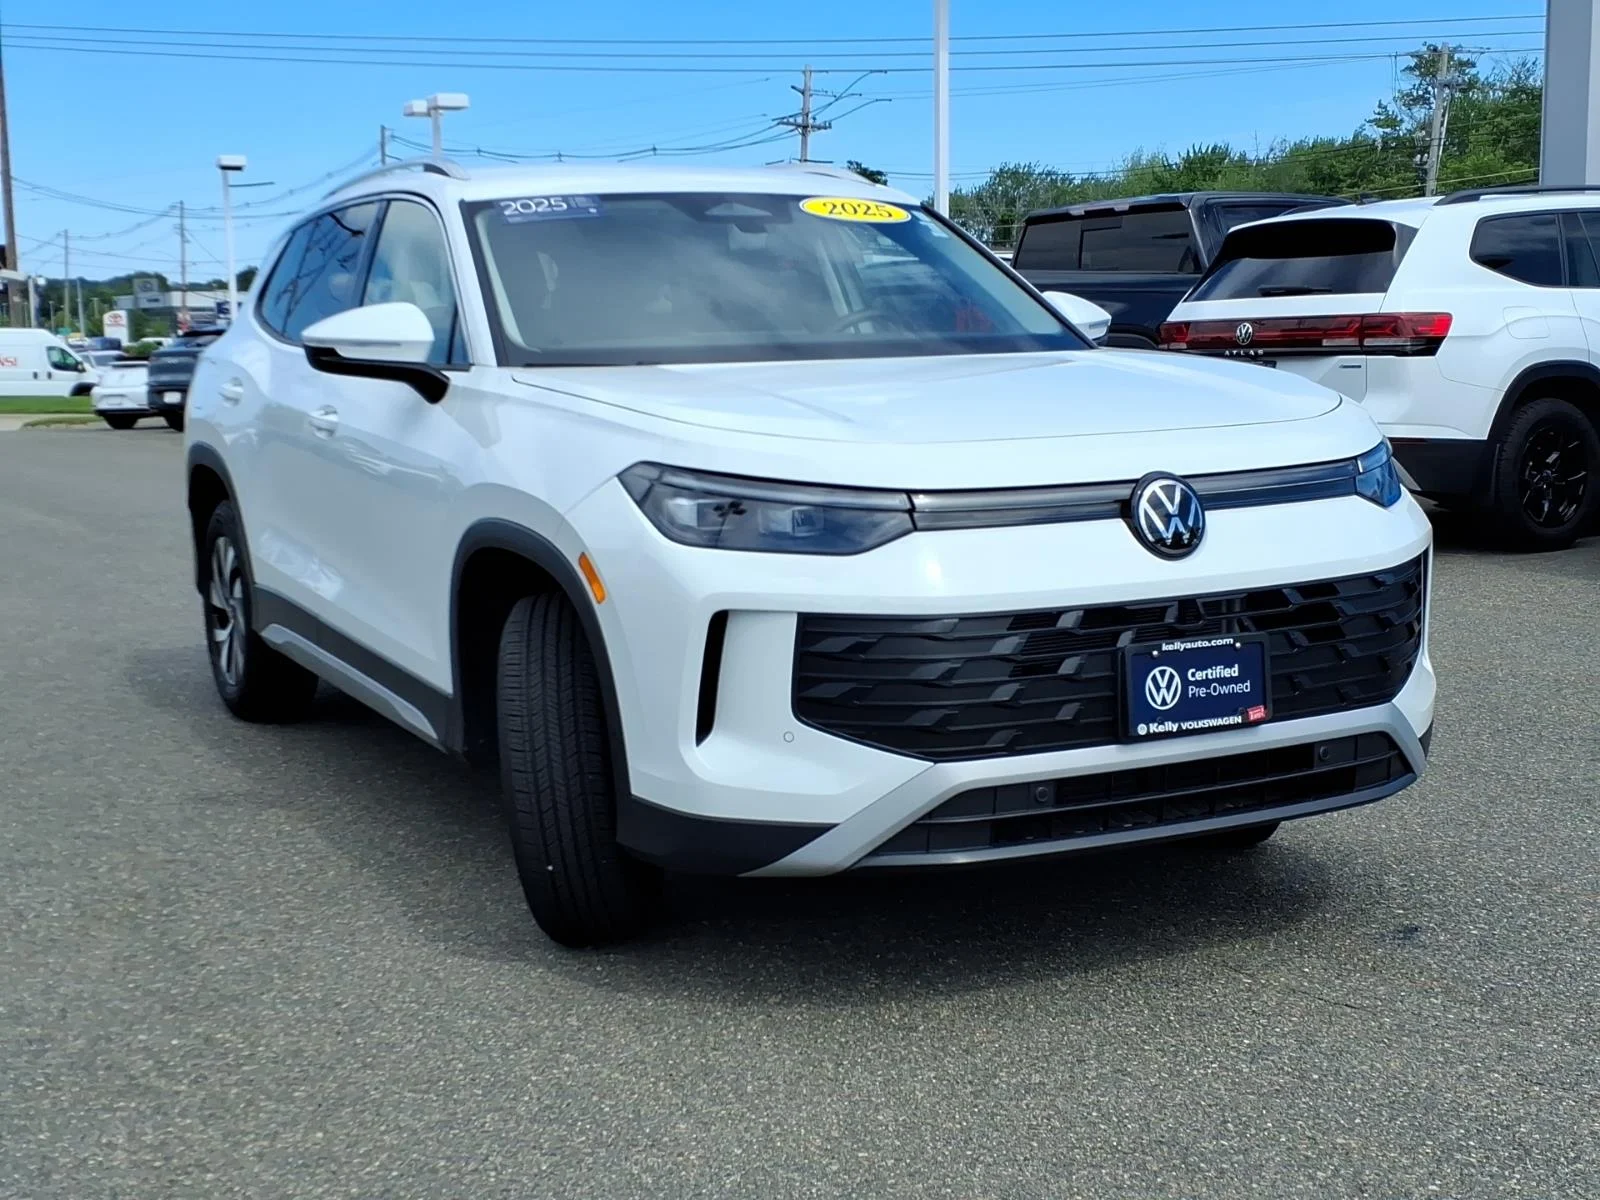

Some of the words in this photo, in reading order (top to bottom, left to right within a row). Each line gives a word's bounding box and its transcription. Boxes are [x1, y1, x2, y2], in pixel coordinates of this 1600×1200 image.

[500, 197, 567, 216] 2025
[823, 201, 893, 218] 2025
[1224, 349, 1264, 357] ATLAS
[1161, 638, 1234, 651] kellyauto.com
[1187, 664, 1239, 681] Certified
[1188, 680, 1251, 698] Pre-Owned
[1149, 720, 1179, 733] Kelly
[1181, 715, 1242, 730] VOLKSWAGEN
